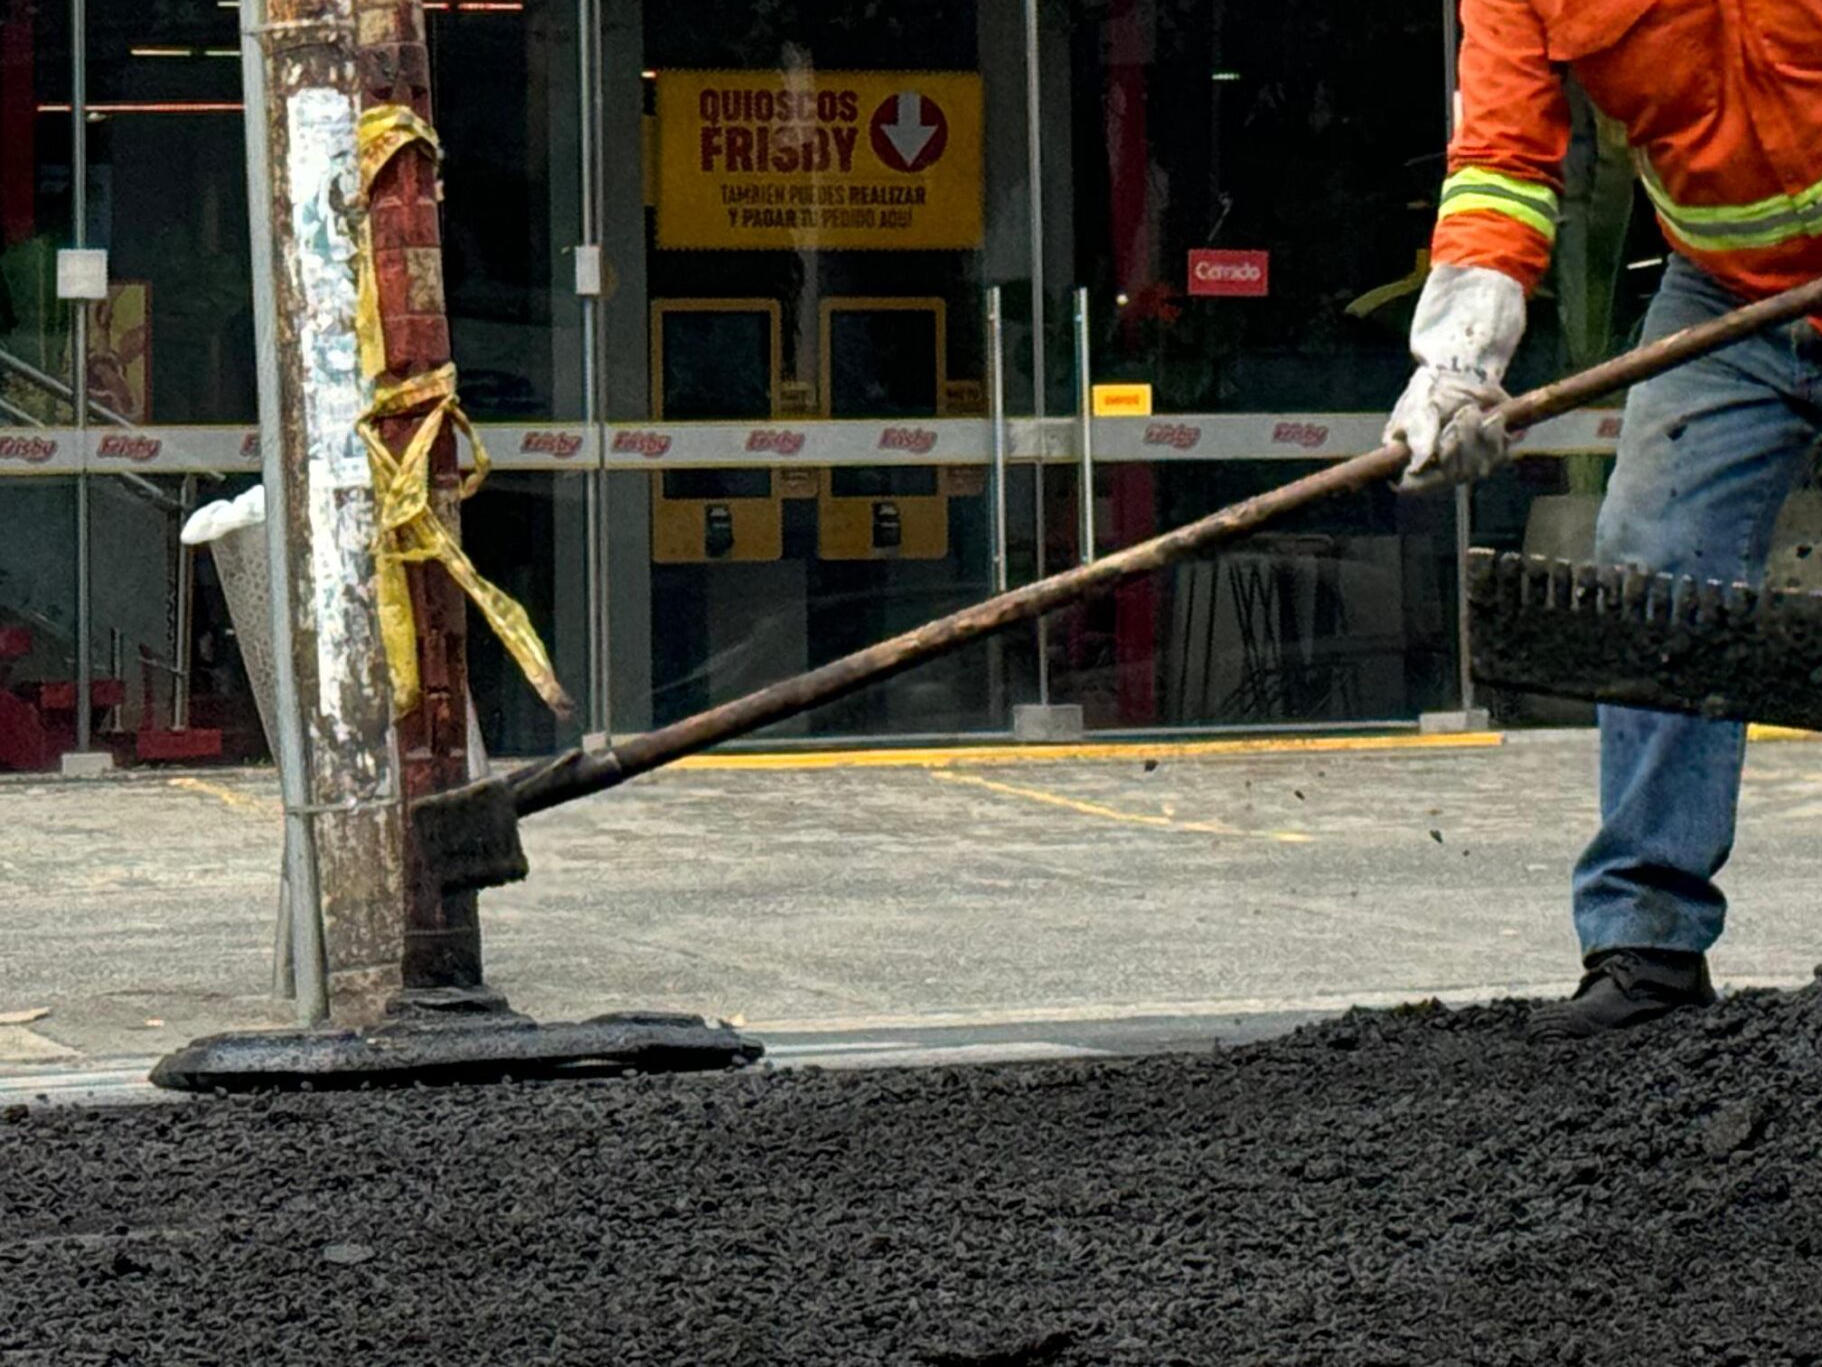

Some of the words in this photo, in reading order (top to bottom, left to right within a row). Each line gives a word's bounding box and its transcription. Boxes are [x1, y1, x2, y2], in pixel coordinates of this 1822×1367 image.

[699, 89, 859, 126] QUIOSCOS
[700, 126, 859, 172] FRISBY
[848, 185, 926, 206] REALIZAR
[728, 208, 738, 228] Y
[742, 208, 797, 228] PAGAR
[97, 434, 162, 462] Frisby
[520, 431, 583, 459] Frisby
[610, 430, 672, 459] Frisby
